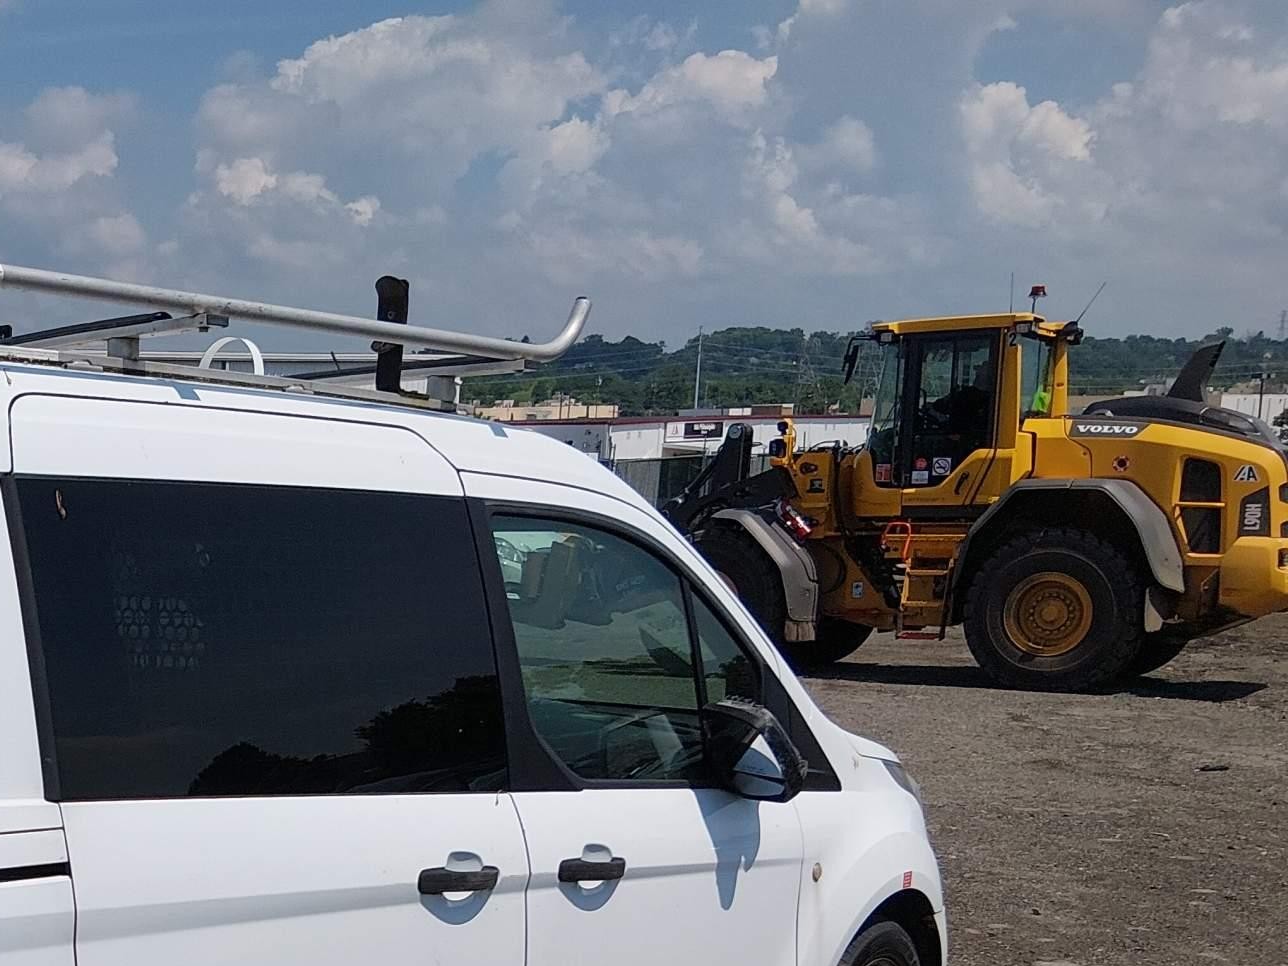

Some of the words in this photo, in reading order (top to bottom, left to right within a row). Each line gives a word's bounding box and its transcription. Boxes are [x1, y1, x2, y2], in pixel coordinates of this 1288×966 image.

[1008, 332, 1017, 347] 2
[1076, 424, 1138, 434] VOLVO
[1243, 503, 1262, 530] L90H
